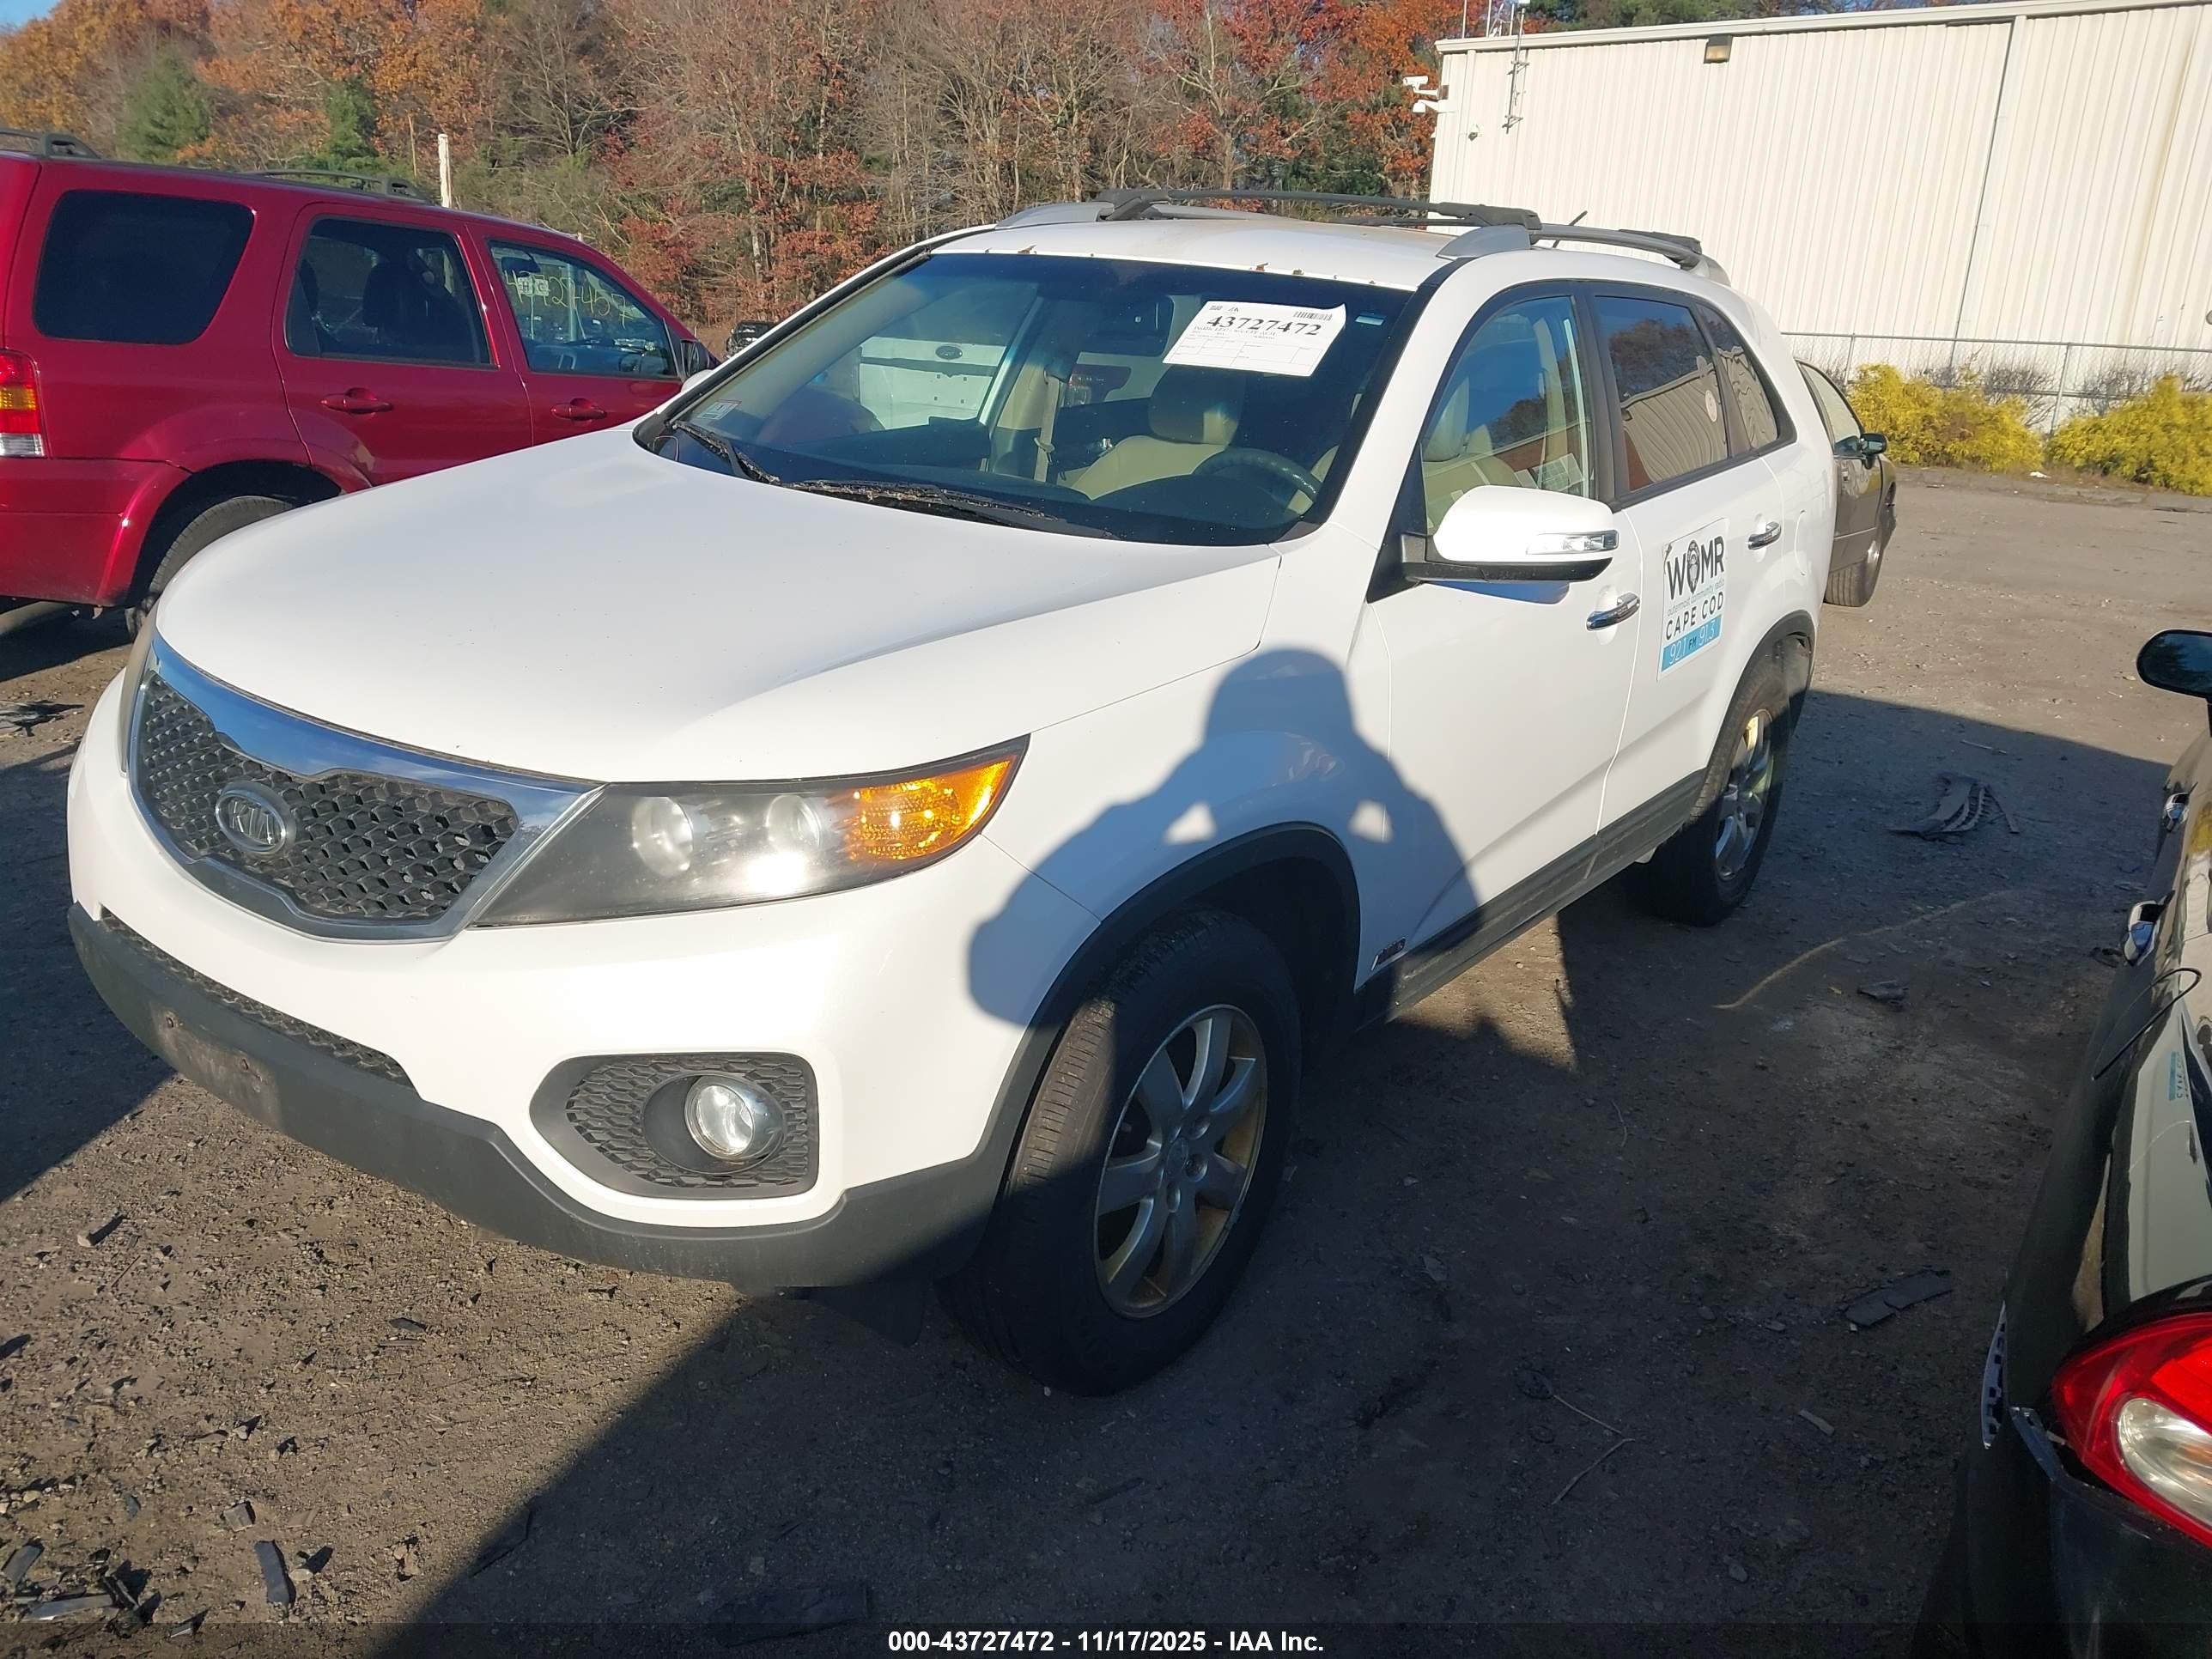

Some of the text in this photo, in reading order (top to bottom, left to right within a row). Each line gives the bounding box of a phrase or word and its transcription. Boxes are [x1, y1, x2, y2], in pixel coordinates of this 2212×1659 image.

[1206, 315, 1322, 336] 43727472
[1667, 535, 1725, 600] WOMR
[1666, 591, 1724, 641] CAPE COD
[228, 800, 274, 845] KIA
